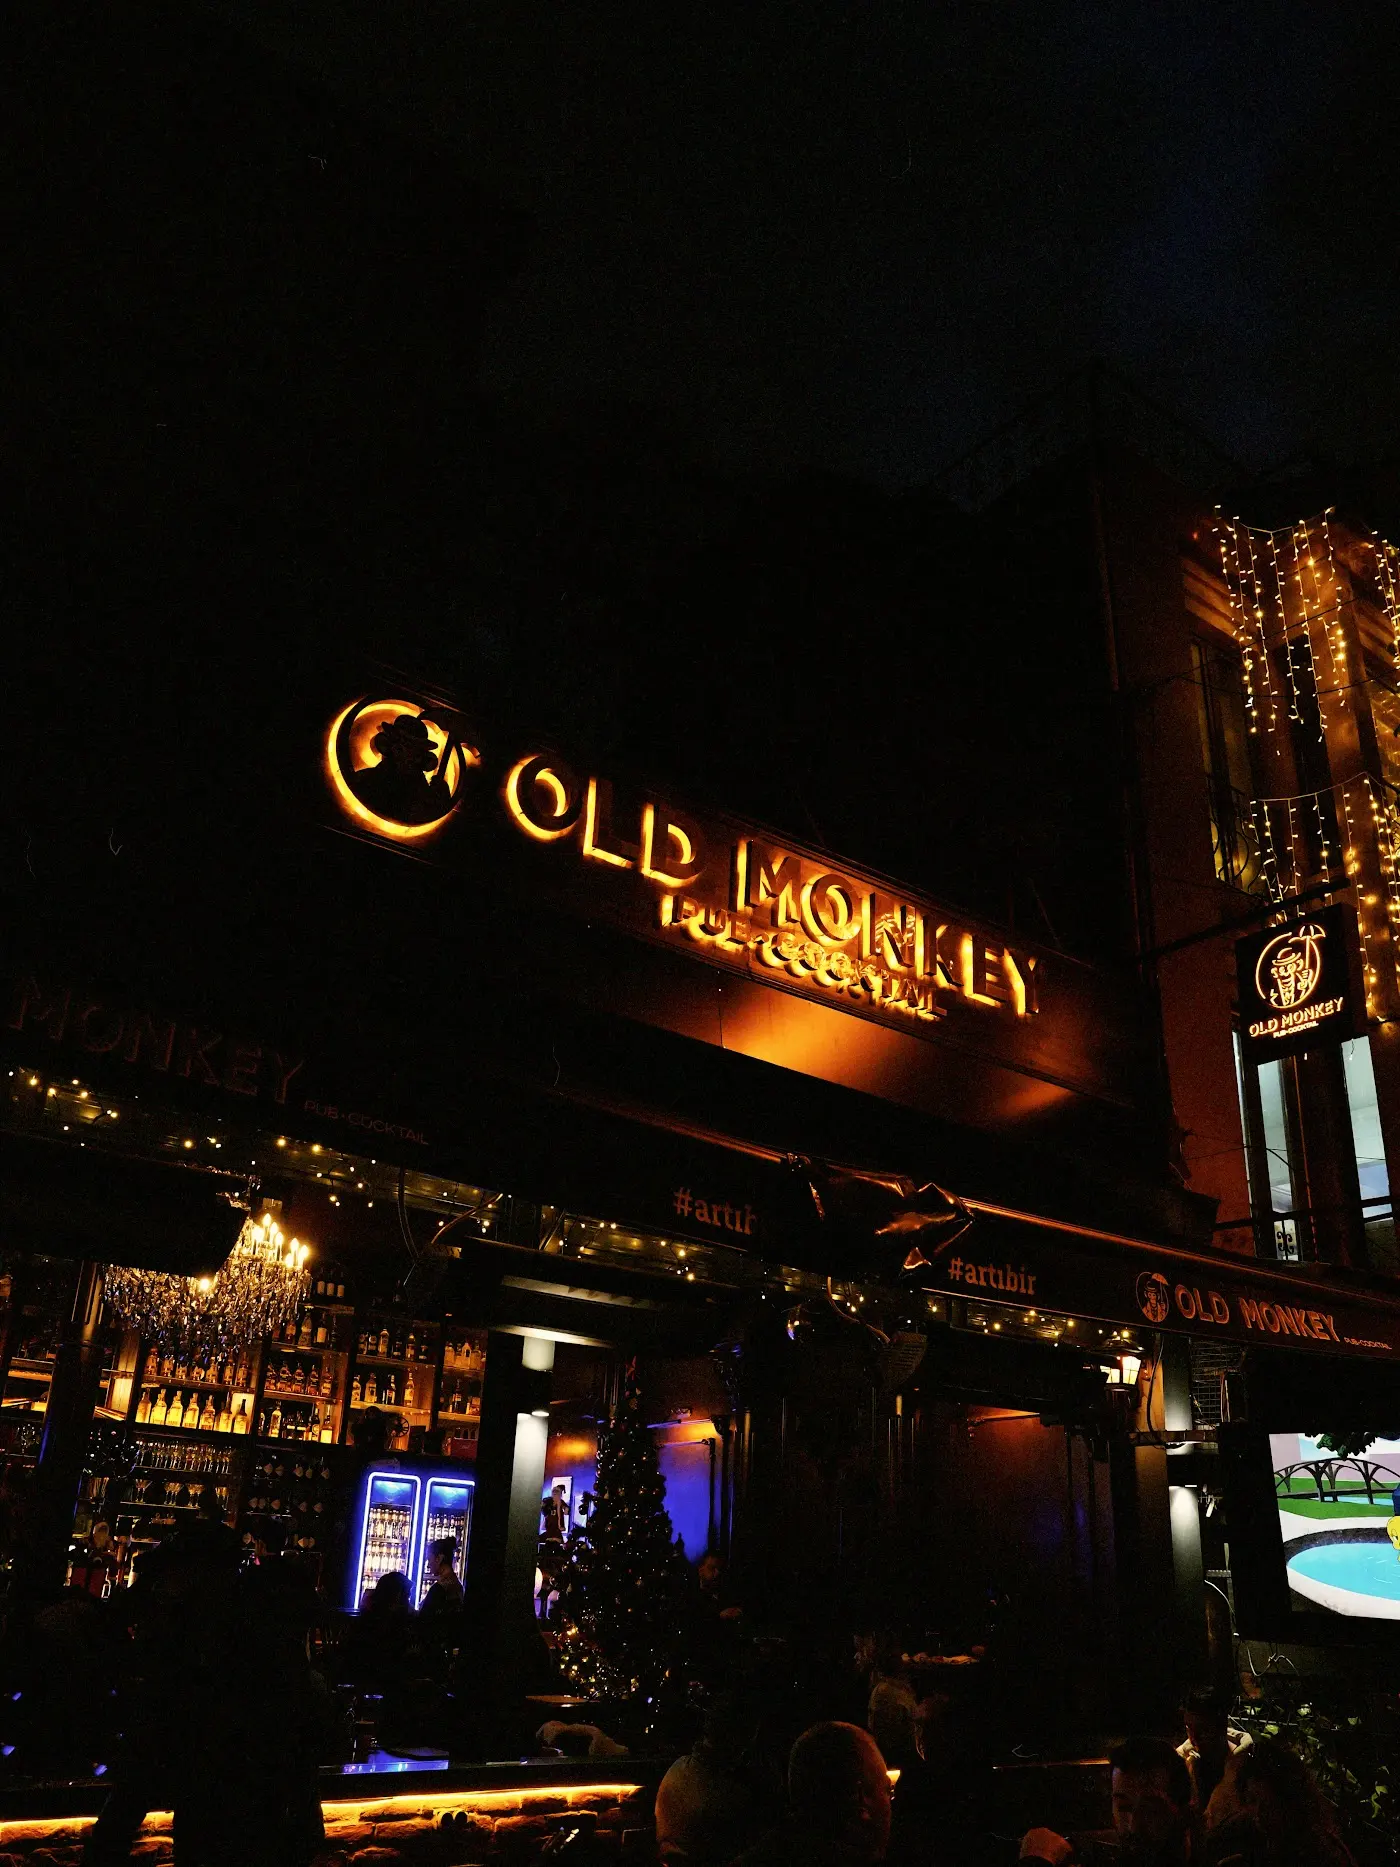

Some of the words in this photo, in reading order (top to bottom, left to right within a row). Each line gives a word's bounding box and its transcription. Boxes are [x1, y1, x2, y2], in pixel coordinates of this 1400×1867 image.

[503, 754, 700, 888] OLD
[730, 836, 1041, 1018] MONKEY
[6, 976, 306, 1104] MONKEY
[1249, 1018, 1279, 1037] OLD
[1280, 996, 1344, 1029] MONKEY
[1174, 1284, 1230, 1324] OLD
[1237, 1296, 1341, 1342] MONKEY
